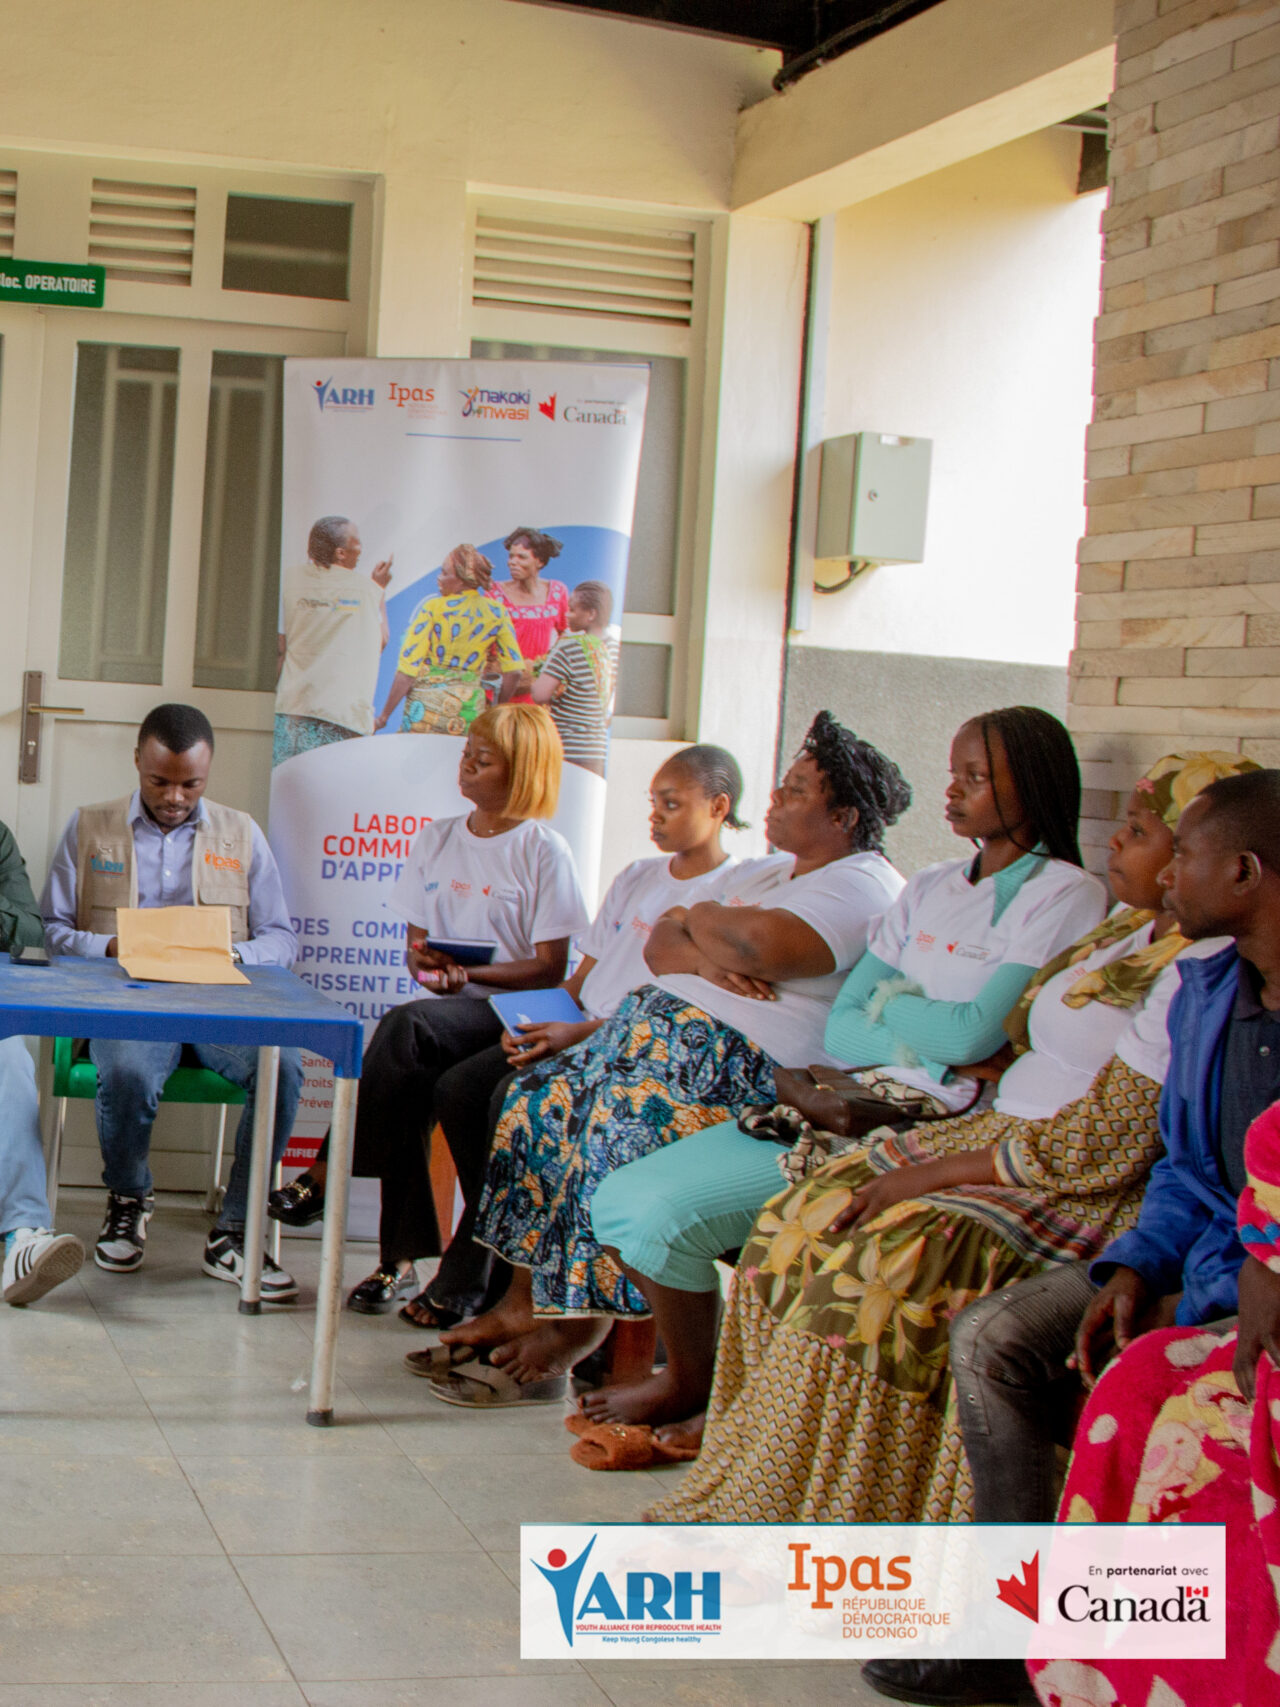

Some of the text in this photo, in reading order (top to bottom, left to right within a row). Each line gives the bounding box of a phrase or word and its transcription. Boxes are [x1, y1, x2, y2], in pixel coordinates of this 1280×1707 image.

[24, 274, 97, 295] OPERATOIRE
[388, 382, 435, 408] Ipas
[563, 405, 627, 426] Canada
[296, 945, 408, 967] PPRENNE
[335, 1000, 399, 1020] OLU
[282, 1147, 320, 1159] TIFIE
